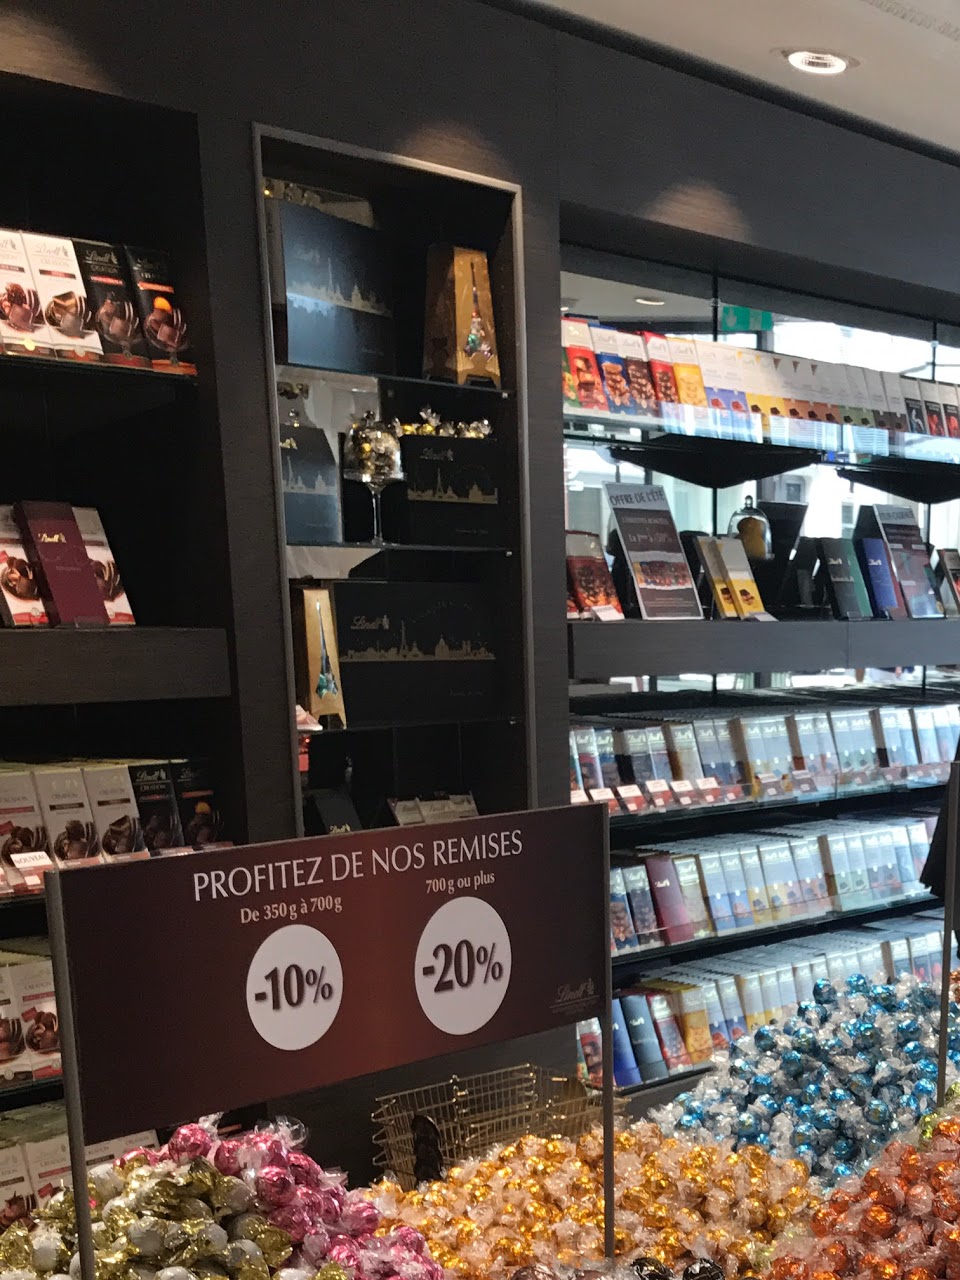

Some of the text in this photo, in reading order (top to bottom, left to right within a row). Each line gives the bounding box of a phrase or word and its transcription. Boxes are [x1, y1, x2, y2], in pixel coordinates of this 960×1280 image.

[351, 616, 382, 630] Lindt
[193, 829, 523, 902] PROFITEZ DE NOS REMISES
[457, 875, 472, 889] ou
[473, 870, 495, 891] plus
[240, 906, 260, 924] De
[300, 897, 308, 913] à
[422, 939, 503, 994] -20%
[254, 963, 334, 1012] -10%
